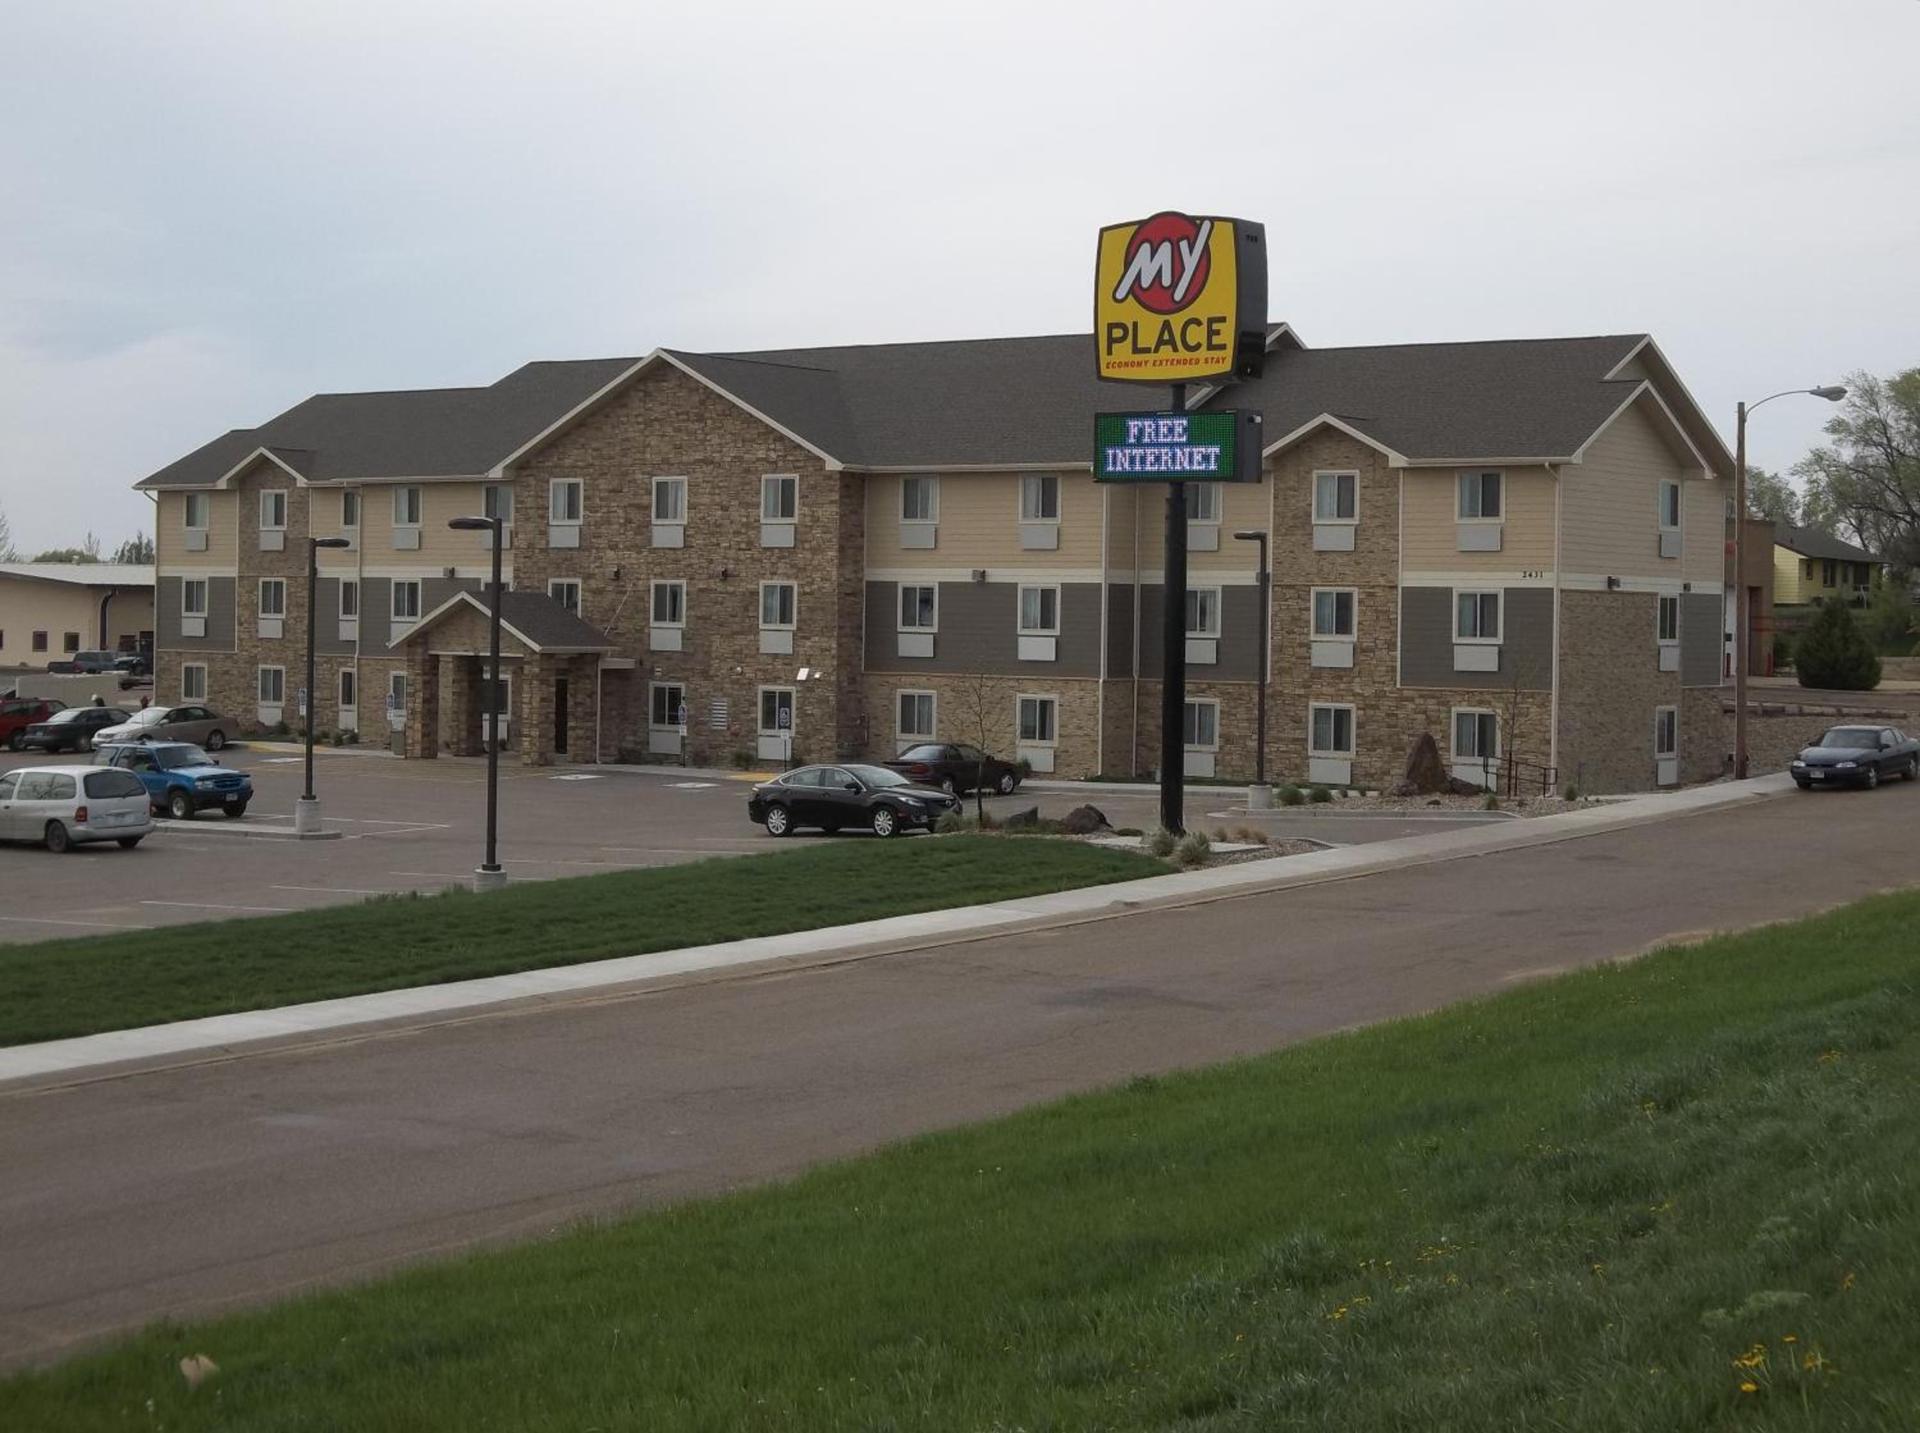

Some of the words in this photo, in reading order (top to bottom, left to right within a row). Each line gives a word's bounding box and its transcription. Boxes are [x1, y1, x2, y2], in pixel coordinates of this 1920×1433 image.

[1106, 316, 1227, 356] PLACE
[1105, 360, 1149, 370] ECONOMY
[1152, 358, 1200, 368] EXTENDED
[1204, 356, 1227, 365] STAY
[1128, 418, 1188, 443] FREE
[1105, 446, 1220, 472] INTERNET
